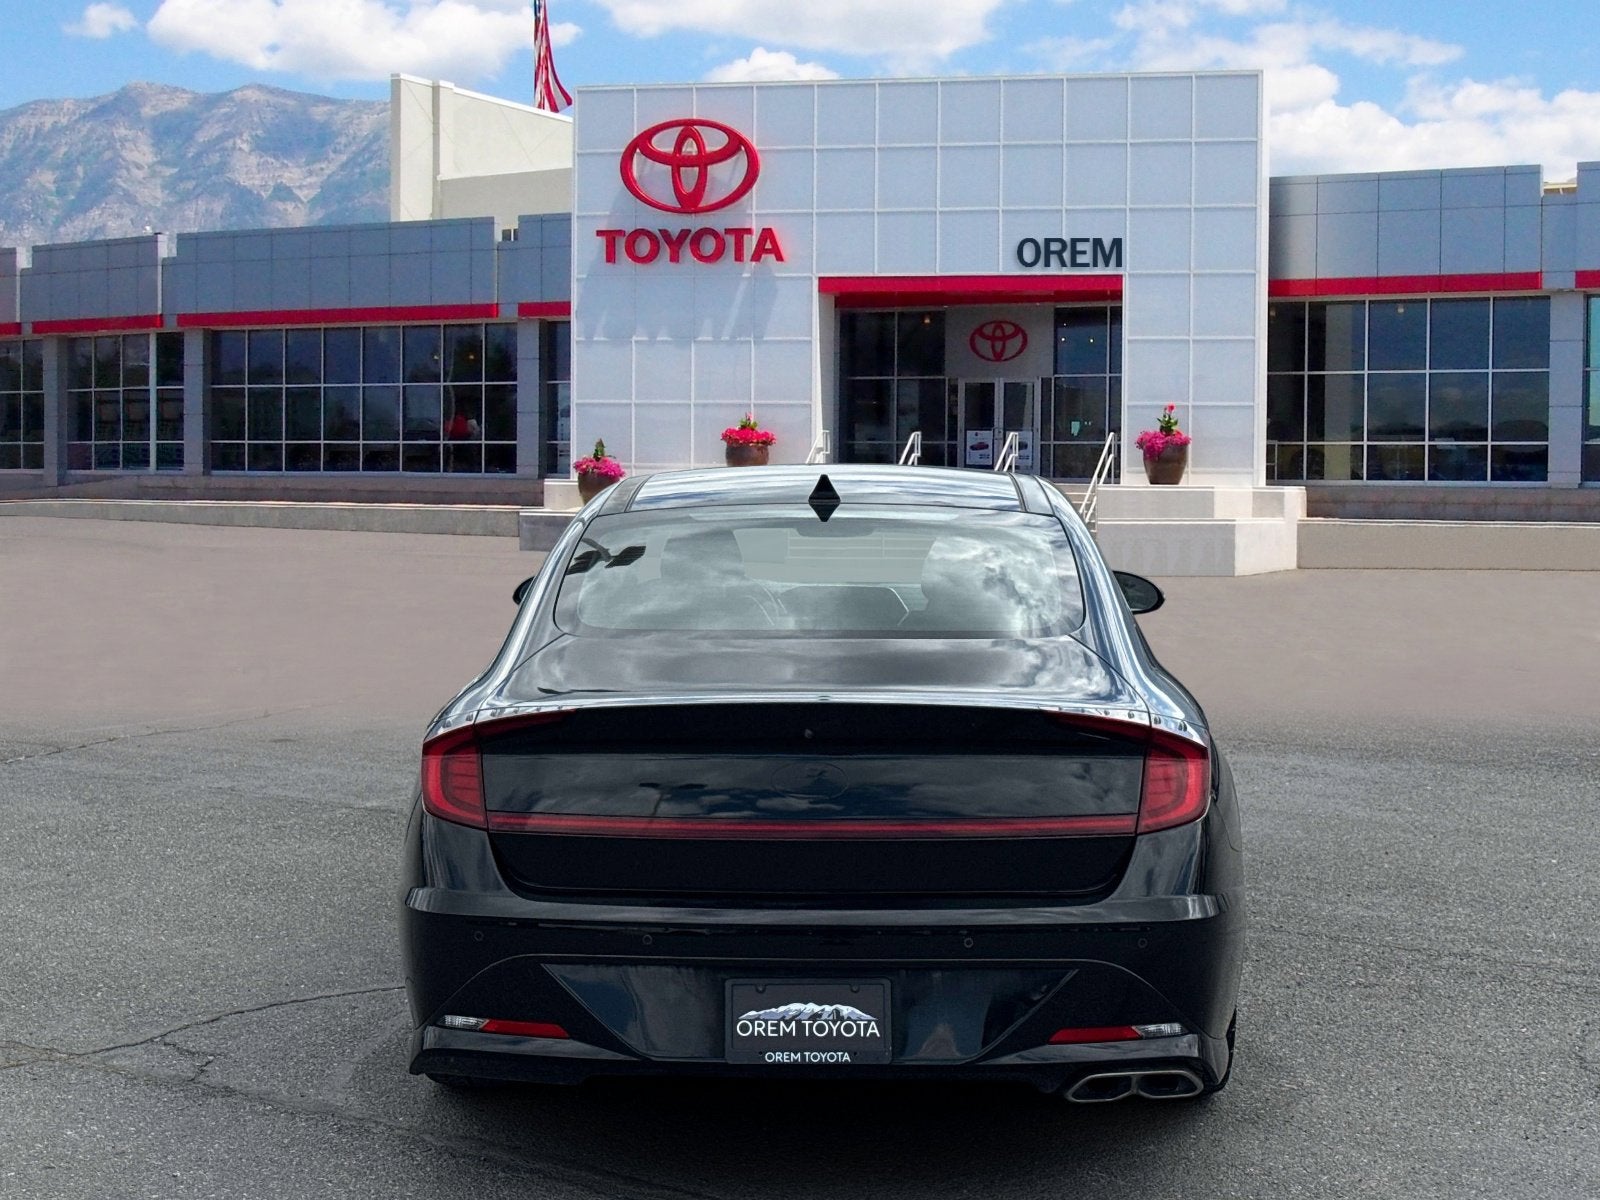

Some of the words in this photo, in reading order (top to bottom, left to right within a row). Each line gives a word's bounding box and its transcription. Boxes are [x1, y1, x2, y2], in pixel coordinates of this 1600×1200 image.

[596, 227, 784, 264] TOYOTA
[1017, 238, 1123, 268] OREM
[736, 1020, 796, 1037] OREM
[801, 1020, 880, 1038] TOYOTA
[765, 1052, 801, 1063] OREM
[804, 1052, 851, 1063] TOYOTA
